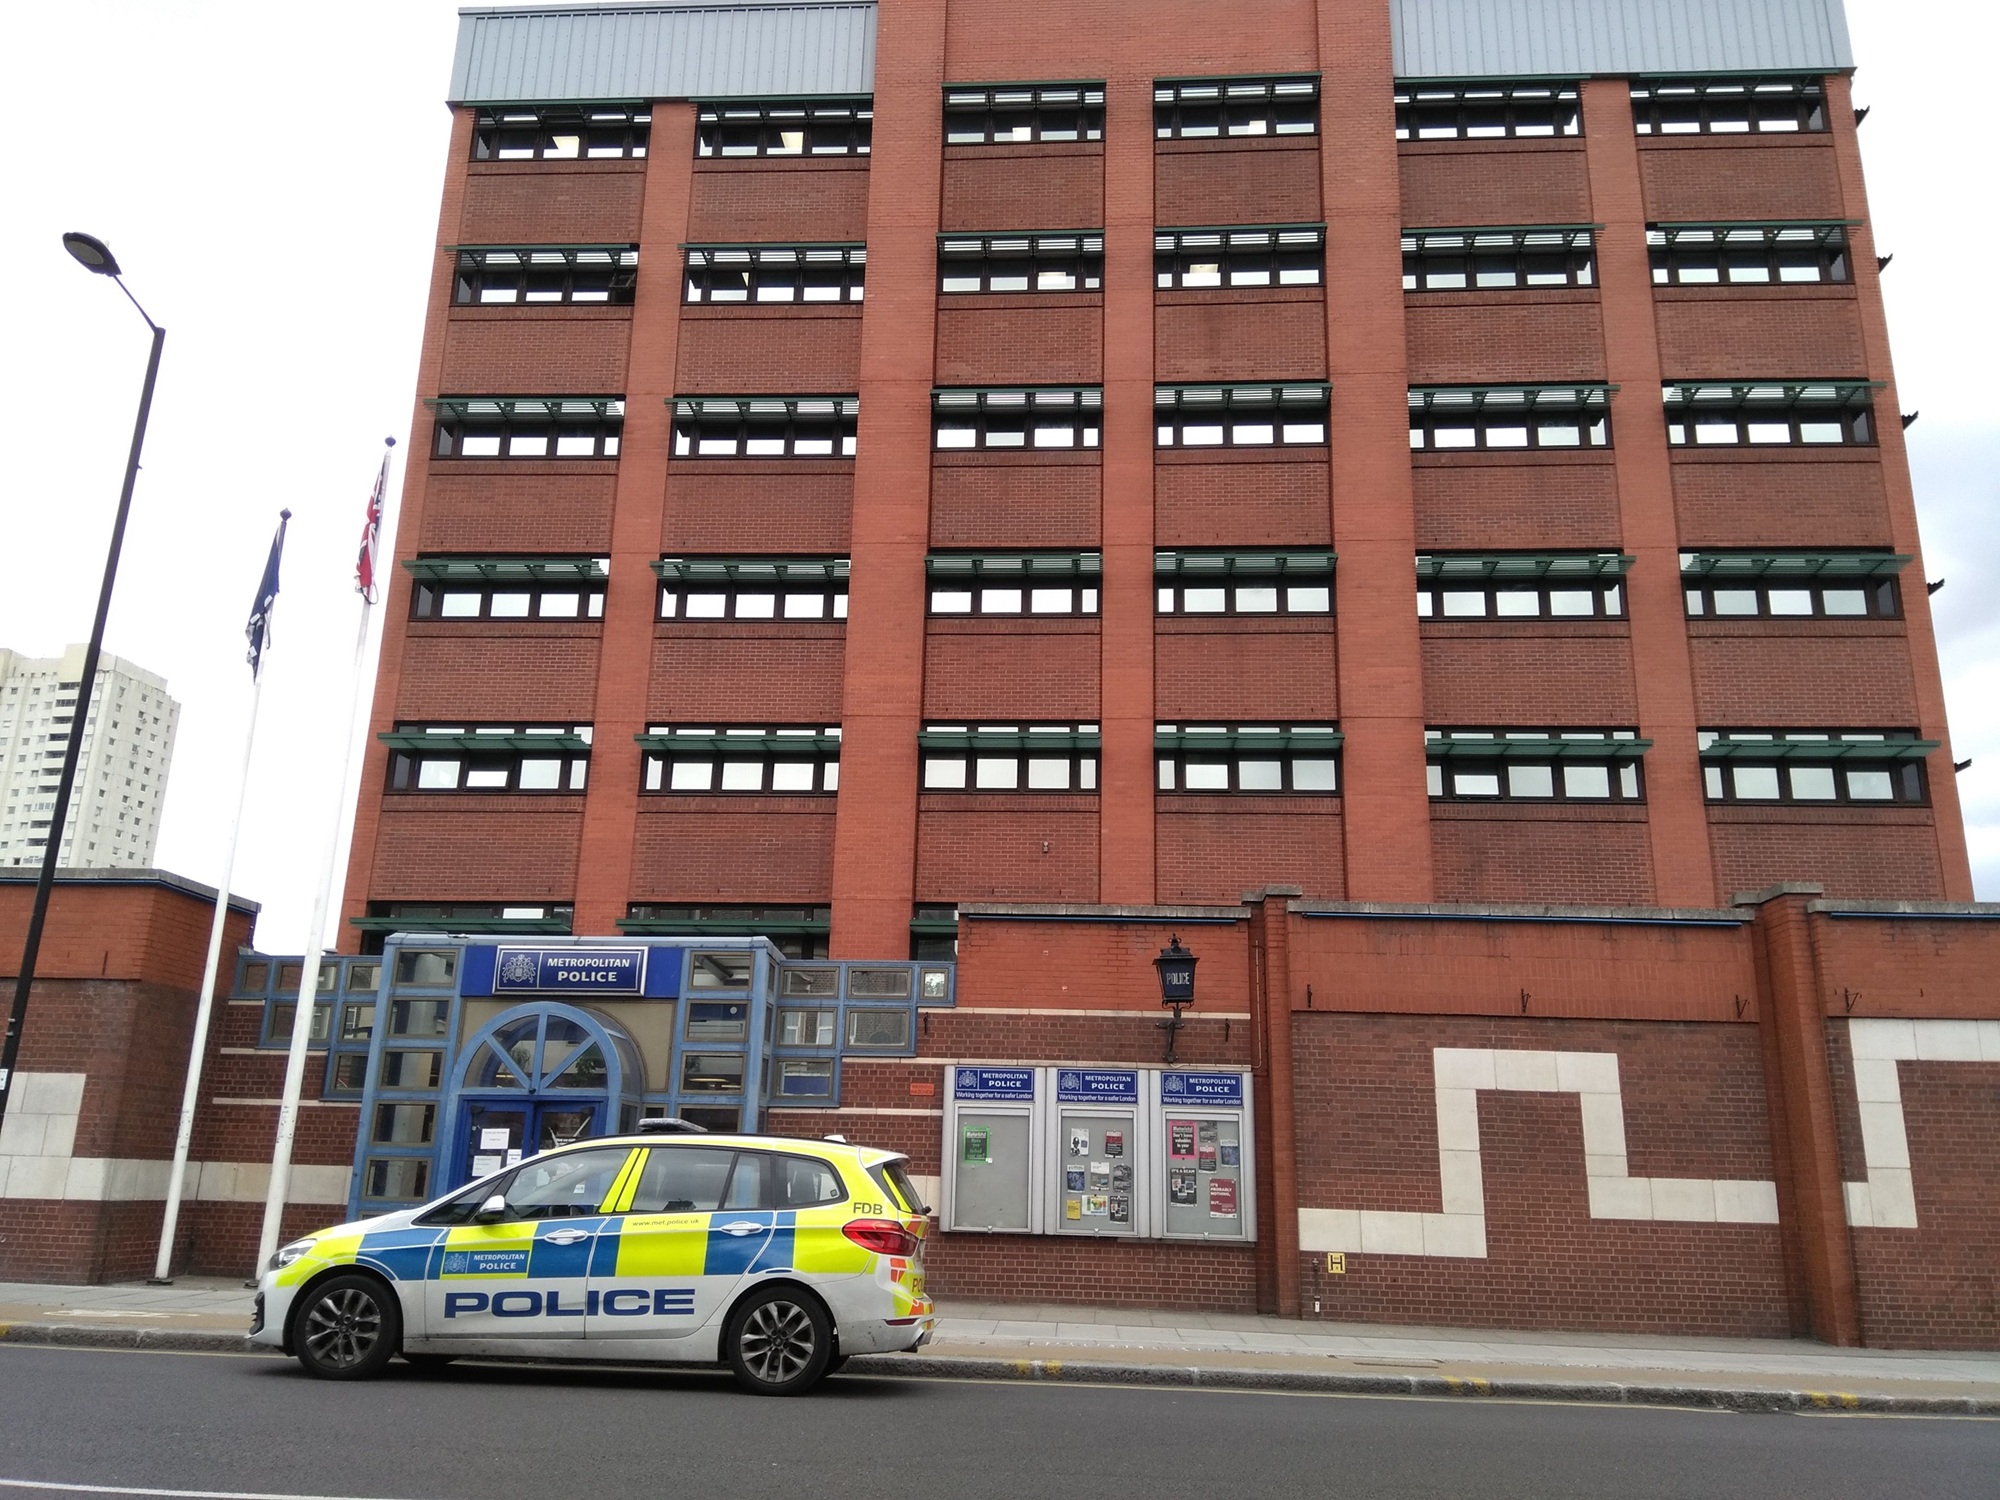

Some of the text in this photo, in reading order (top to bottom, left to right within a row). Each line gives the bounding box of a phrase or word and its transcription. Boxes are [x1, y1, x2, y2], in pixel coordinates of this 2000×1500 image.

[547, 958, 630, 967] METROPOLITAN
[557, 971, 617, 982] POLICE
[1166, 972, 1190, 985] POLICE
[1163, 1096, 1182, 1104] Working
[853, 1202, 883, 1215] FDB
[473, 1253, 525, 1261] METROPOLITAN
[1330, 1254, 1343, 1271] H
[479, 1262, 517, 1270] POLICE
[912, 1278, 924, 1293] PO
[444, 1288, 696, 1319] POLICE
